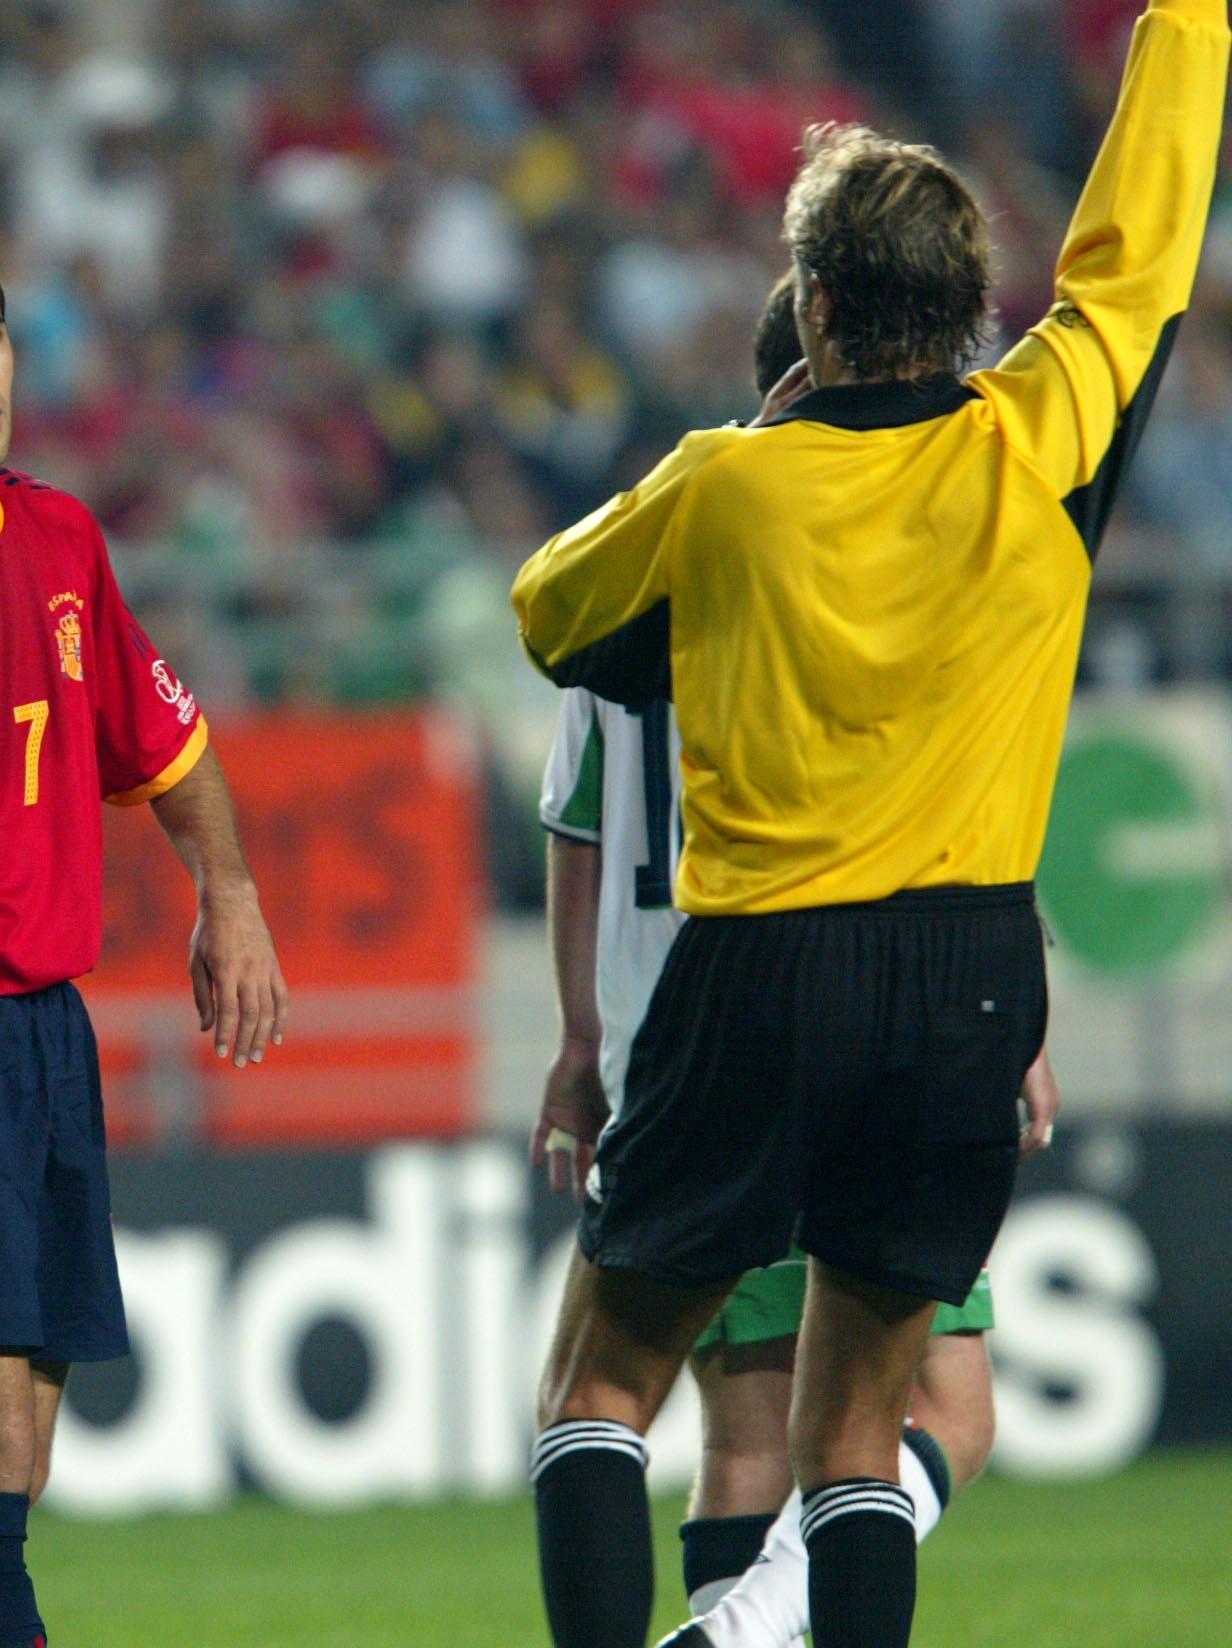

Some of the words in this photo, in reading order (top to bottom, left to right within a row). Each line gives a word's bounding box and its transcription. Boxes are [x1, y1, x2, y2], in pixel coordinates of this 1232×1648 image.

[13, 700, 50, 806] 7
[625, 700, 683, 910] 1
[39, 1143, 1170, 1508] adis
